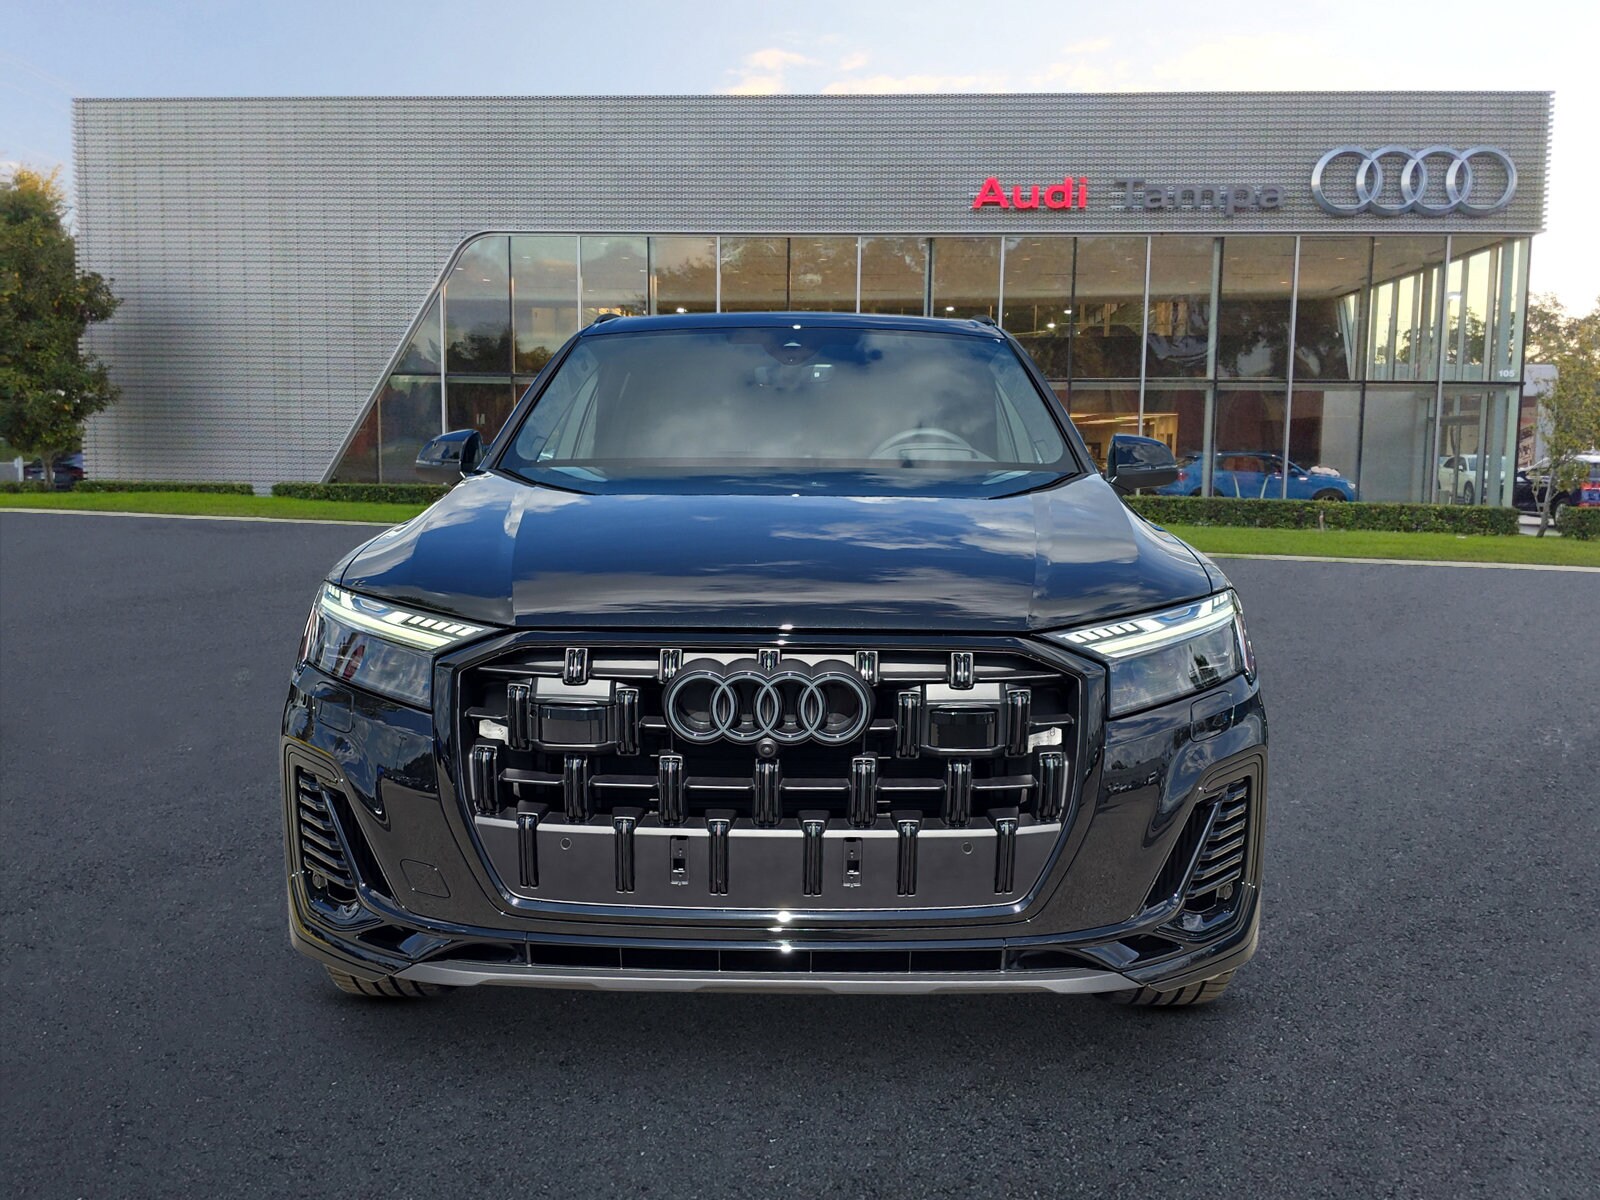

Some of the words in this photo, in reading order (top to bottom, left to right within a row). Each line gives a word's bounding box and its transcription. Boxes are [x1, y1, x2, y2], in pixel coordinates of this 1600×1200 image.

[972, 176, 1088, 210] Audi
[1116, 177, 1285, 216] Tampa
[1499, 369, 1515, 378] 105
